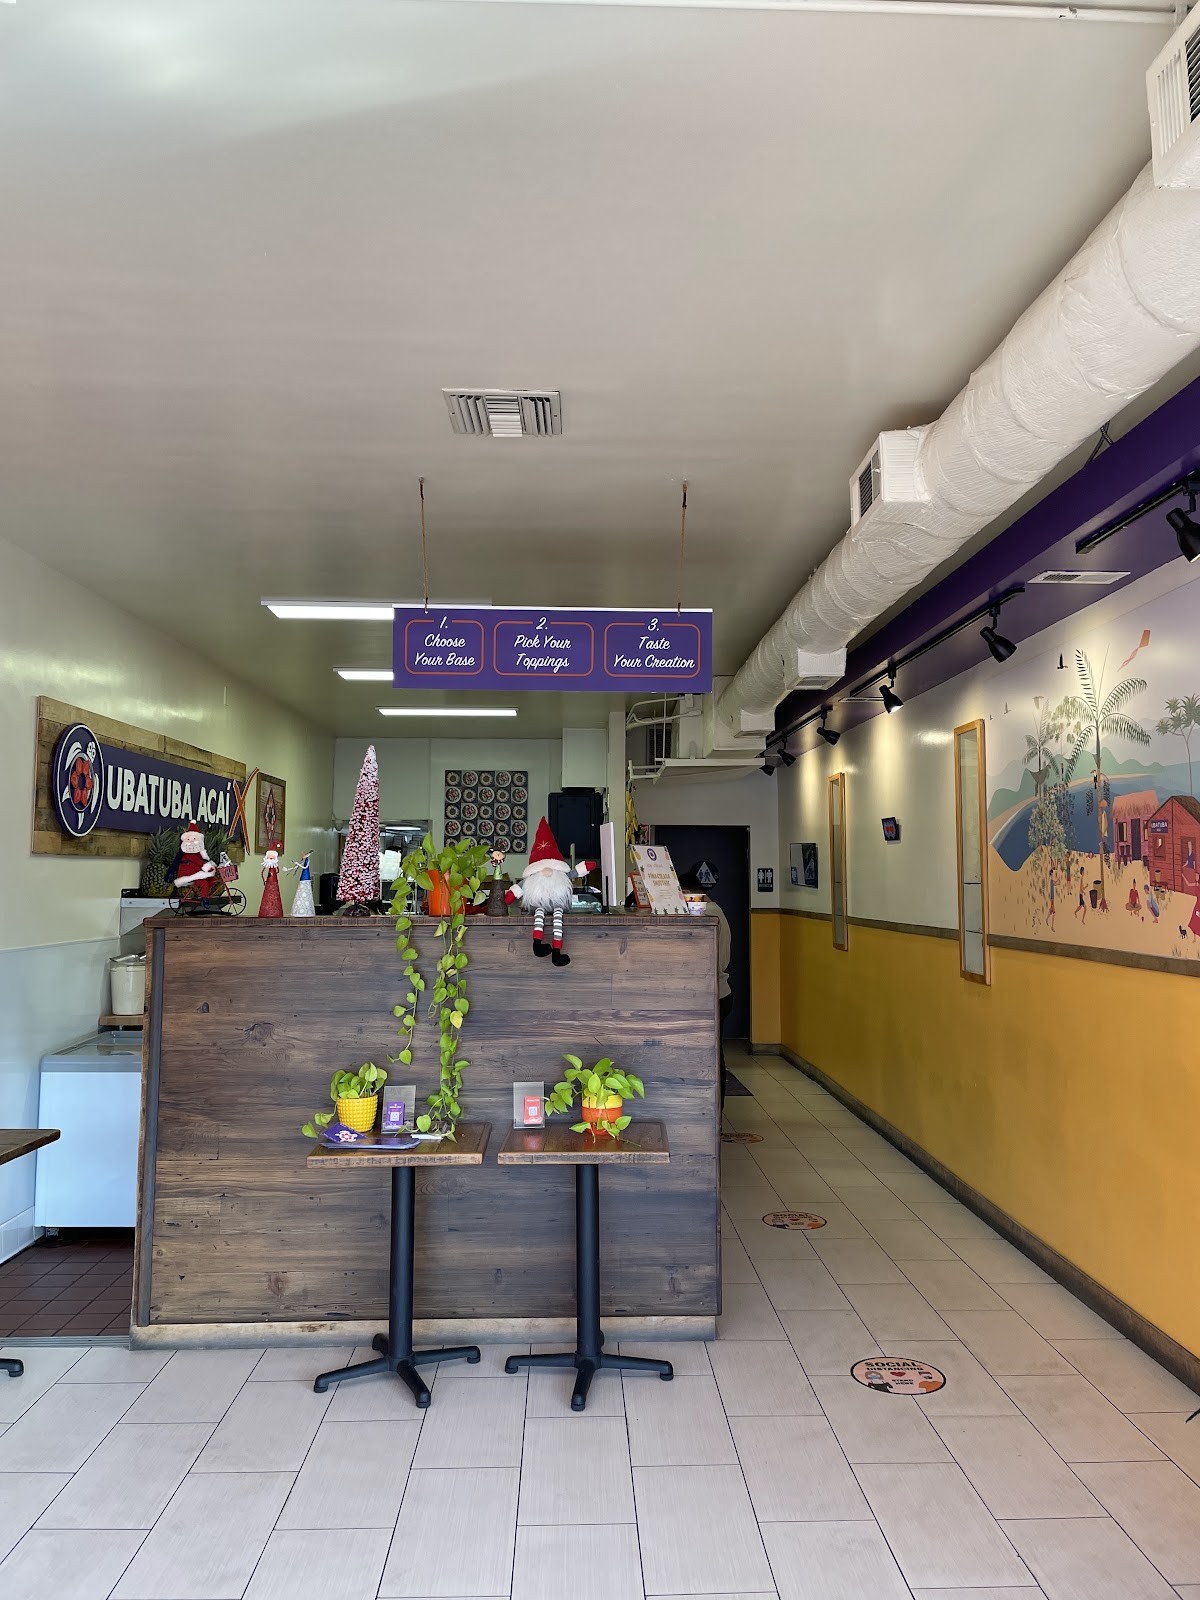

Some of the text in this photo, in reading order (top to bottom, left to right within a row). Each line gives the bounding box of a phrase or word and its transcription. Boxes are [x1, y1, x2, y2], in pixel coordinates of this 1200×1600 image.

[439, 616, 449, 630] 1.
[535, 616, 549, 631] 2.
[647, 617, 660, 632] 3.
[424, 633, 466, 648] Choose
[513, 635, 571, 650] Pick Your
[638, 636, 671, 650] Taste
[413, 652, 475, 666] Your Base
[516, 653, 570, 674] Toppings
[613, 655, 696, 669] Your Creation
[106, 765, 232, 828] UBATUBA AÇAÍ
